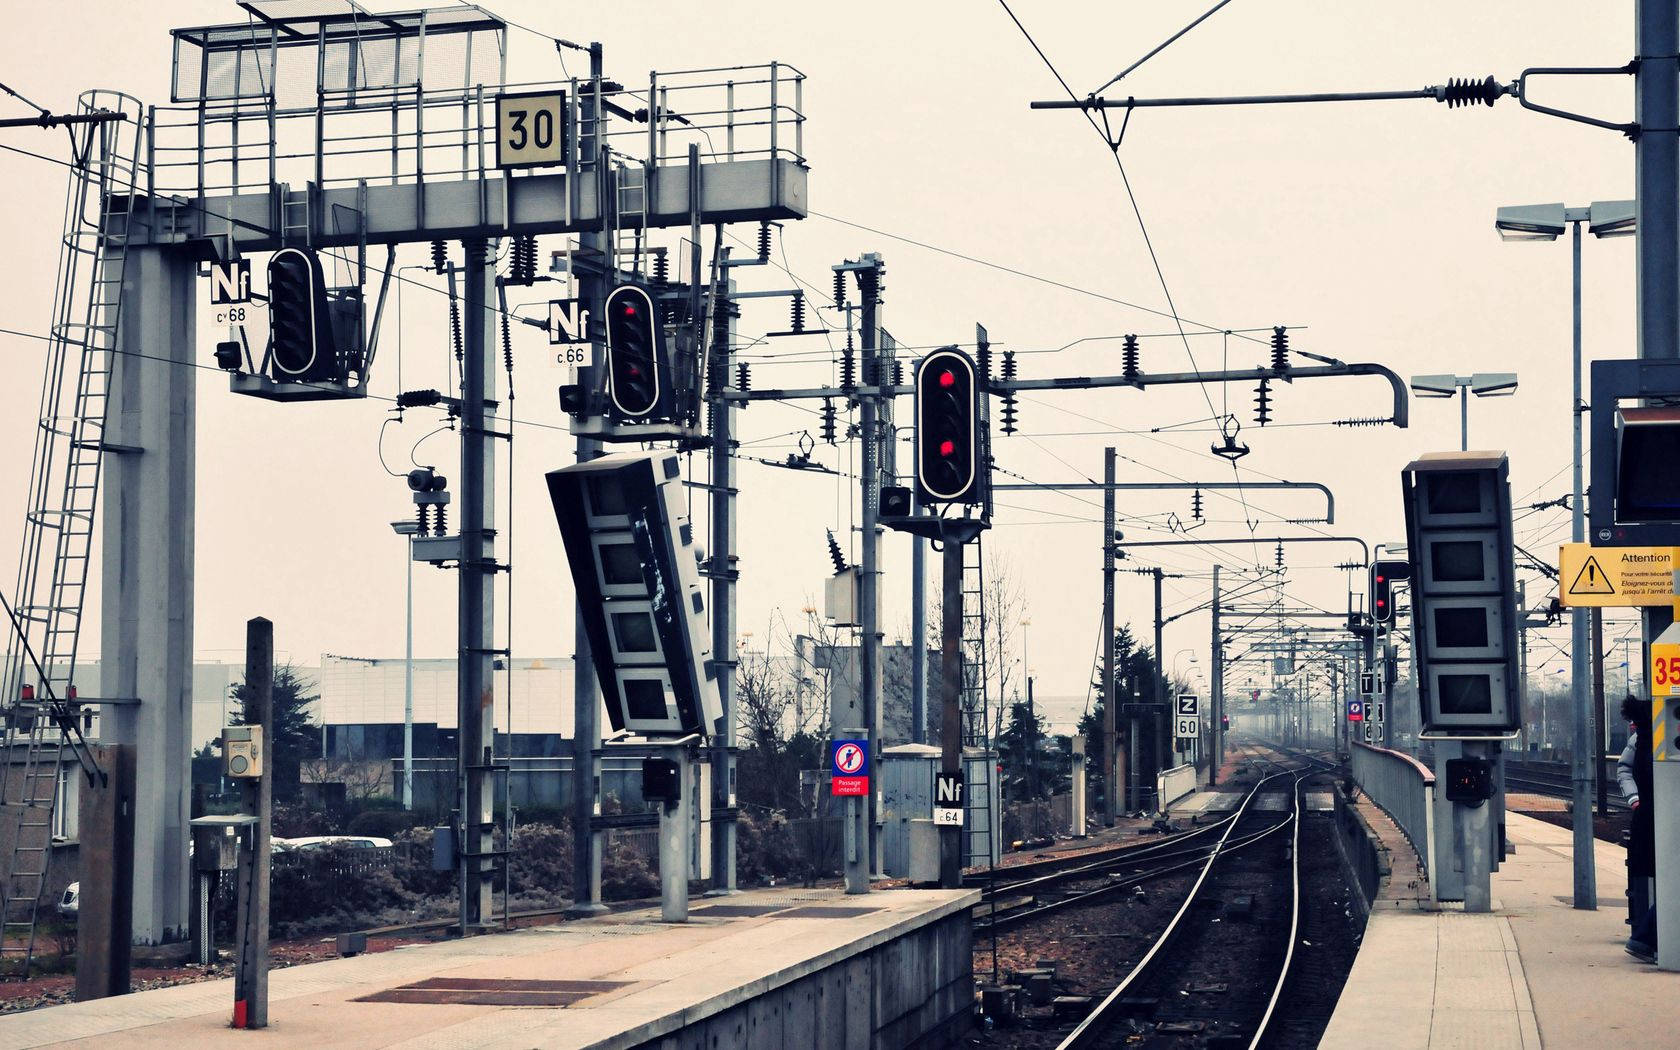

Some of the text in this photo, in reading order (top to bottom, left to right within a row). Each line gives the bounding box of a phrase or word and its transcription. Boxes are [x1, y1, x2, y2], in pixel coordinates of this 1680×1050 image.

[508, 109, 553, 150] 30
[211, 263, 250, 301] Nf
[549, 302, 590, 342] Nf
[1621, 553, 1671, 563] Attention
[1655, 657, 1680, 686] 35
[1182, 699, 1194, 712] Z
[1180, 720, 1196, 734] 60
[838, 779, 862, 788] Passage
[938, 777, 963, 802] Nf
